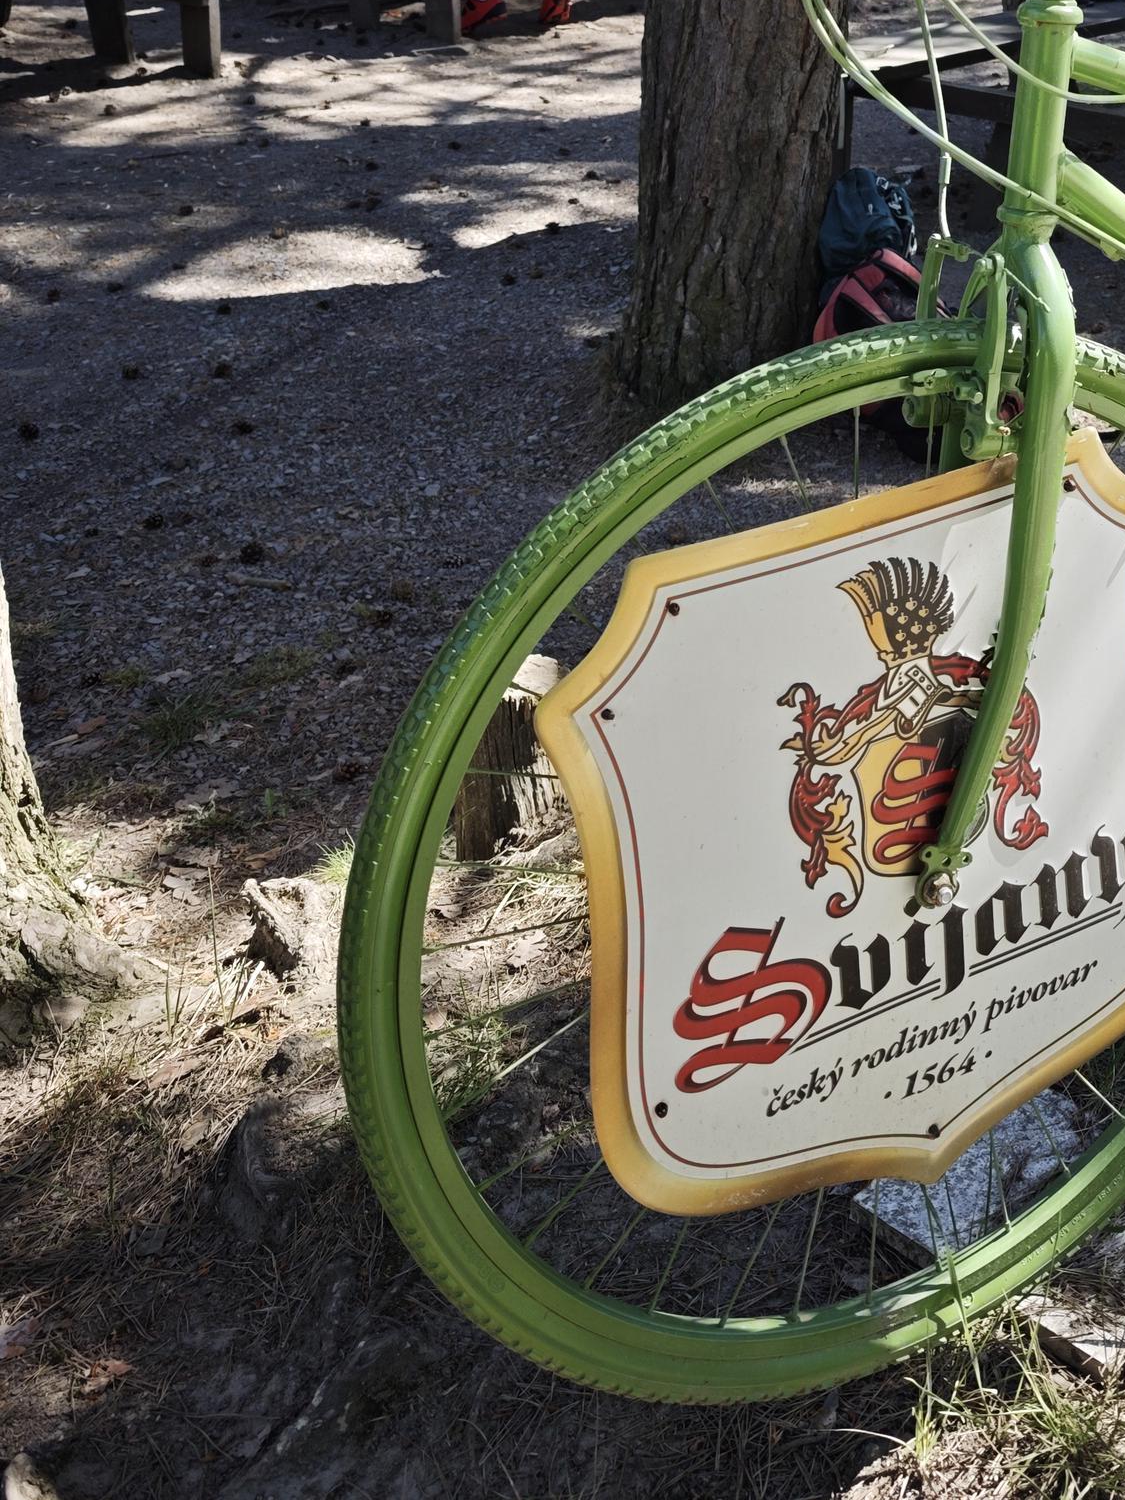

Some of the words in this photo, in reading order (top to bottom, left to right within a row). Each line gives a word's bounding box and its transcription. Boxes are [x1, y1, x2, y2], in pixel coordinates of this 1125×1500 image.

[765, 1056, 846, 1118] český
[850, 1003, 978, 1072] rodinný
[983, 961, 1098, 1035] pivovar
[903, 1053, 976, 1105] 1564
